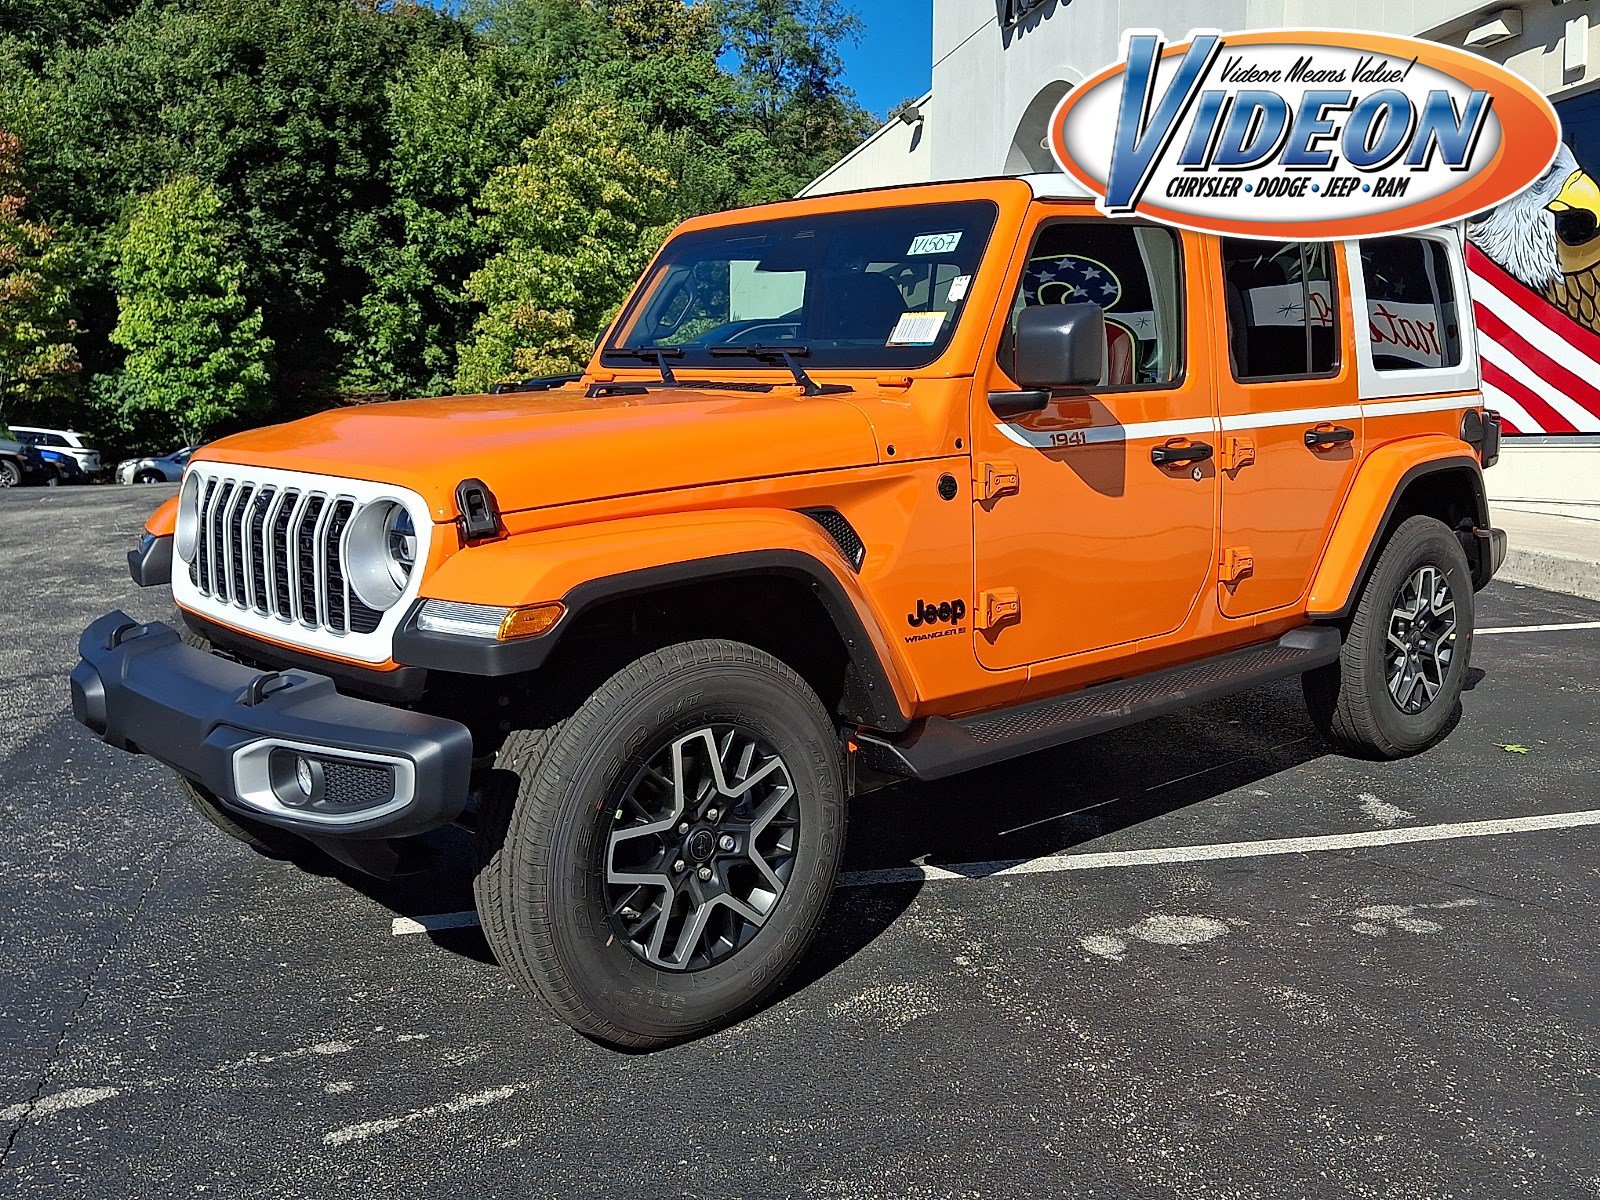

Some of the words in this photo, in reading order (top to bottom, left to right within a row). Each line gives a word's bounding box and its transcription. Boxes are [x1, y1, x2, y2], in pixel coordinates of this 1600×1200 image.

[1049, 430, 1087, 447] 1941
[907, 598, 966, 628] Jeep
[904, 628, 957, 644] WRANGLER
